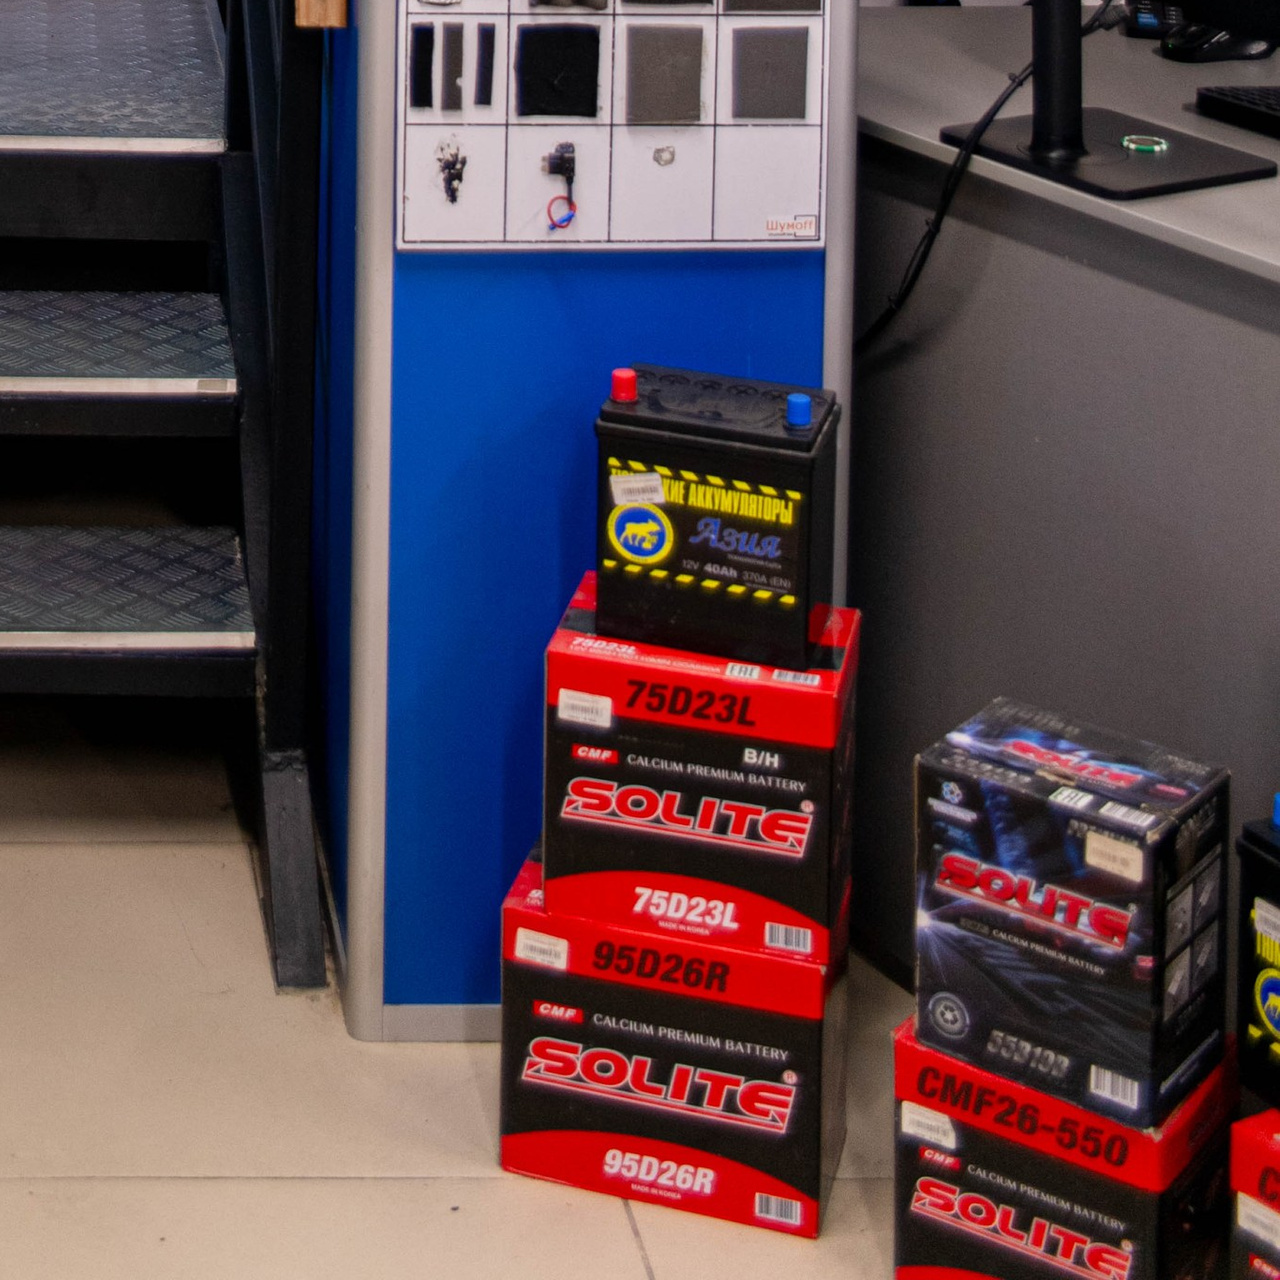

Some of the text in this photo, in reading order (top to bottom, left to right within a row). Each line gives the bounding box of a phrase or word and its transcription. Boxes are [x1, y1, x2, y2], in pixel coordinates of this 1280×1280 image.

[687, 482, 794, 525] АККУМУЛЯТОРЫ
[689, 516, 783, 560] Азия
[682, 559, 700, 570] 12V
[703, 562, 738, 579] 40Ah
[625, 680, 756, 726] 75D23L
[577, 746, 612, 760] CMF
[626, 753, 807, 793] CALCIUM PREMIUM BATTERY
[743, 747, 780, 768] B/H
[562, 776, 814, 851] SOLITE
[632, 886, 740, 930] 75D23L
[936, 851, 1132, 945] SOLITE
[593, 940, 730, 991] 95D26R
[992, 928, 1106, 976] CALCIUM PREMIUM BATTERY
[539, 1003, 576, 1019] CMF
[592, 1013, 789, 1061] CALCIUM PREMIUM BATTERY
[523, 1036, 797, 1128] SOLITE
[916, 1066, 1130, 1167] CMF26-550
[603, 1148, 716, 1195] 95D26R
[923, 1149, 955, 1165] CMF
[967, 1163, 1127, 1231] CALCIUM PREMIUM BATTERY
[911, 1176, 1133, 1279] SOLITE
